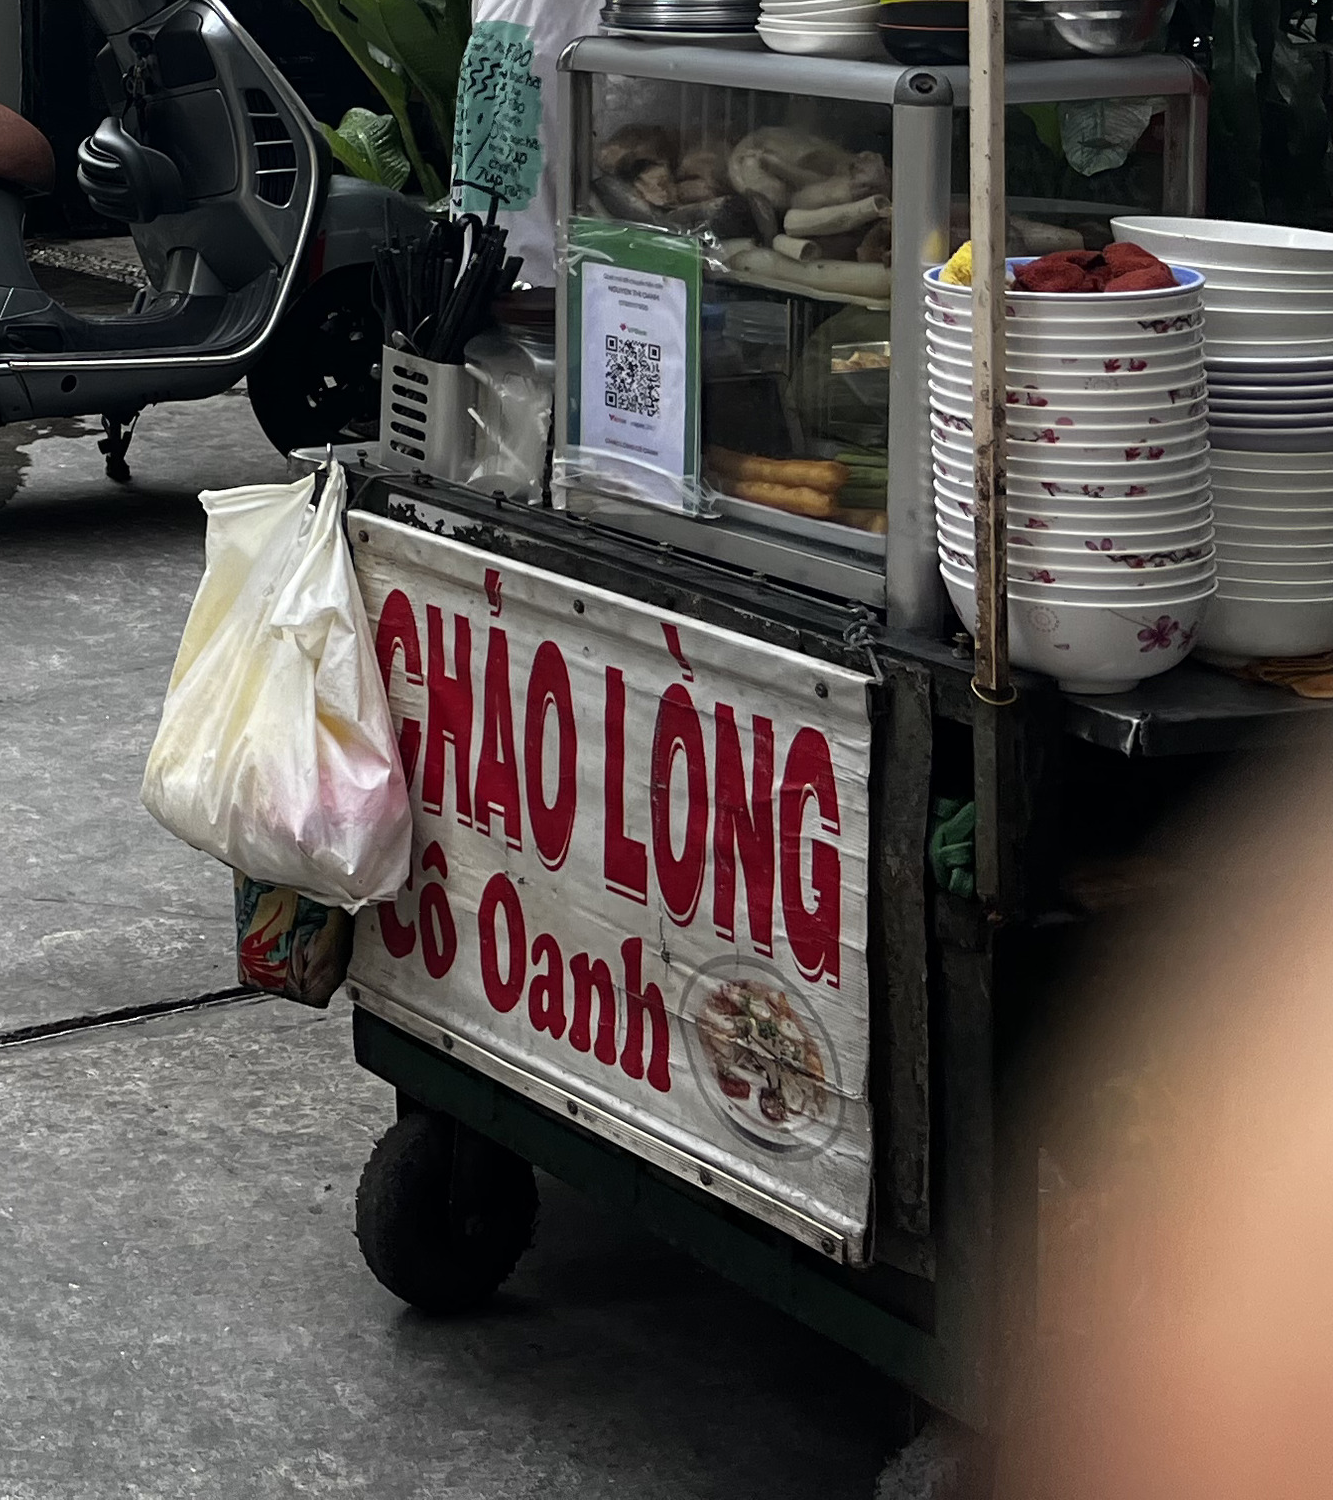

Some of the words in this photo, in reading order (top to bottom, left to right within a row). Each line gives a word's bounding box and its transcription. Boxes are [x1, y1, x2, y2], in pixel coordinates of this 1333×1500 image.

[375, 568, 577, 872] CHÁO
[604, 622, 841, 989] LÒNG
[478, 873, 671, 1092] Oanh
